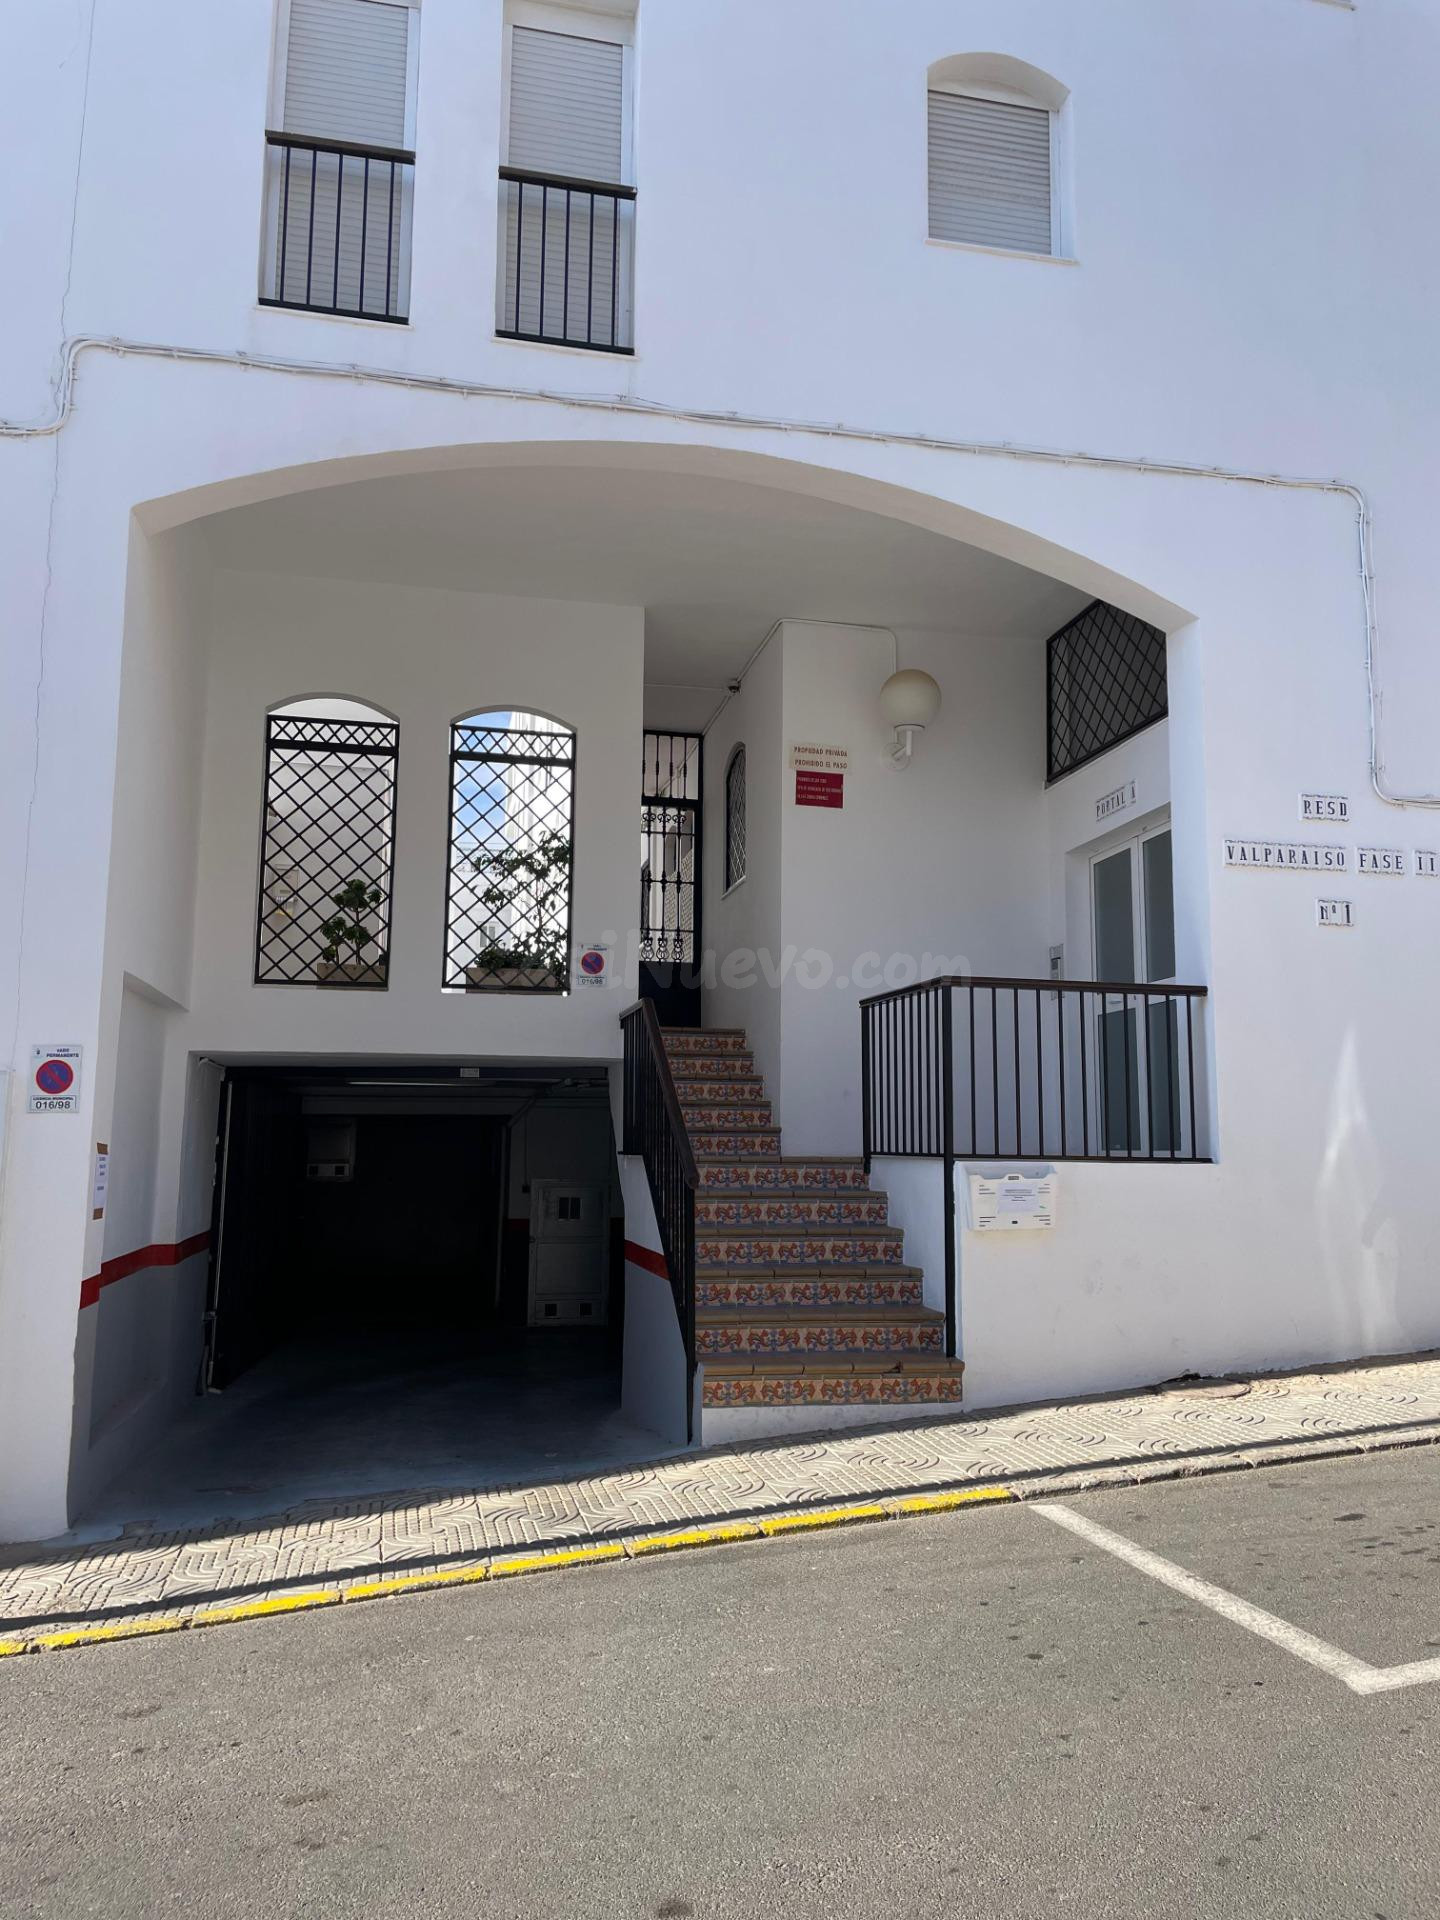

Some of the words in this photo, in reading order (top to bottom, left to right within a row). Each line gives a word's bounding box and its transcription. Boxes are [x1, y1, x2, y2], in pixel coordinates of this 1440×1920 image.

[825, 749, 848, 757] PRIVADA
[1303, 799, 1348, 816] RESD
[1227, 845, 1345, 866] VALPARAISO
[1359, 853, 1403, 870] FASE
[1418, 856, 1436, 872] II
[35, 1100, 71, 1110] 016/98
